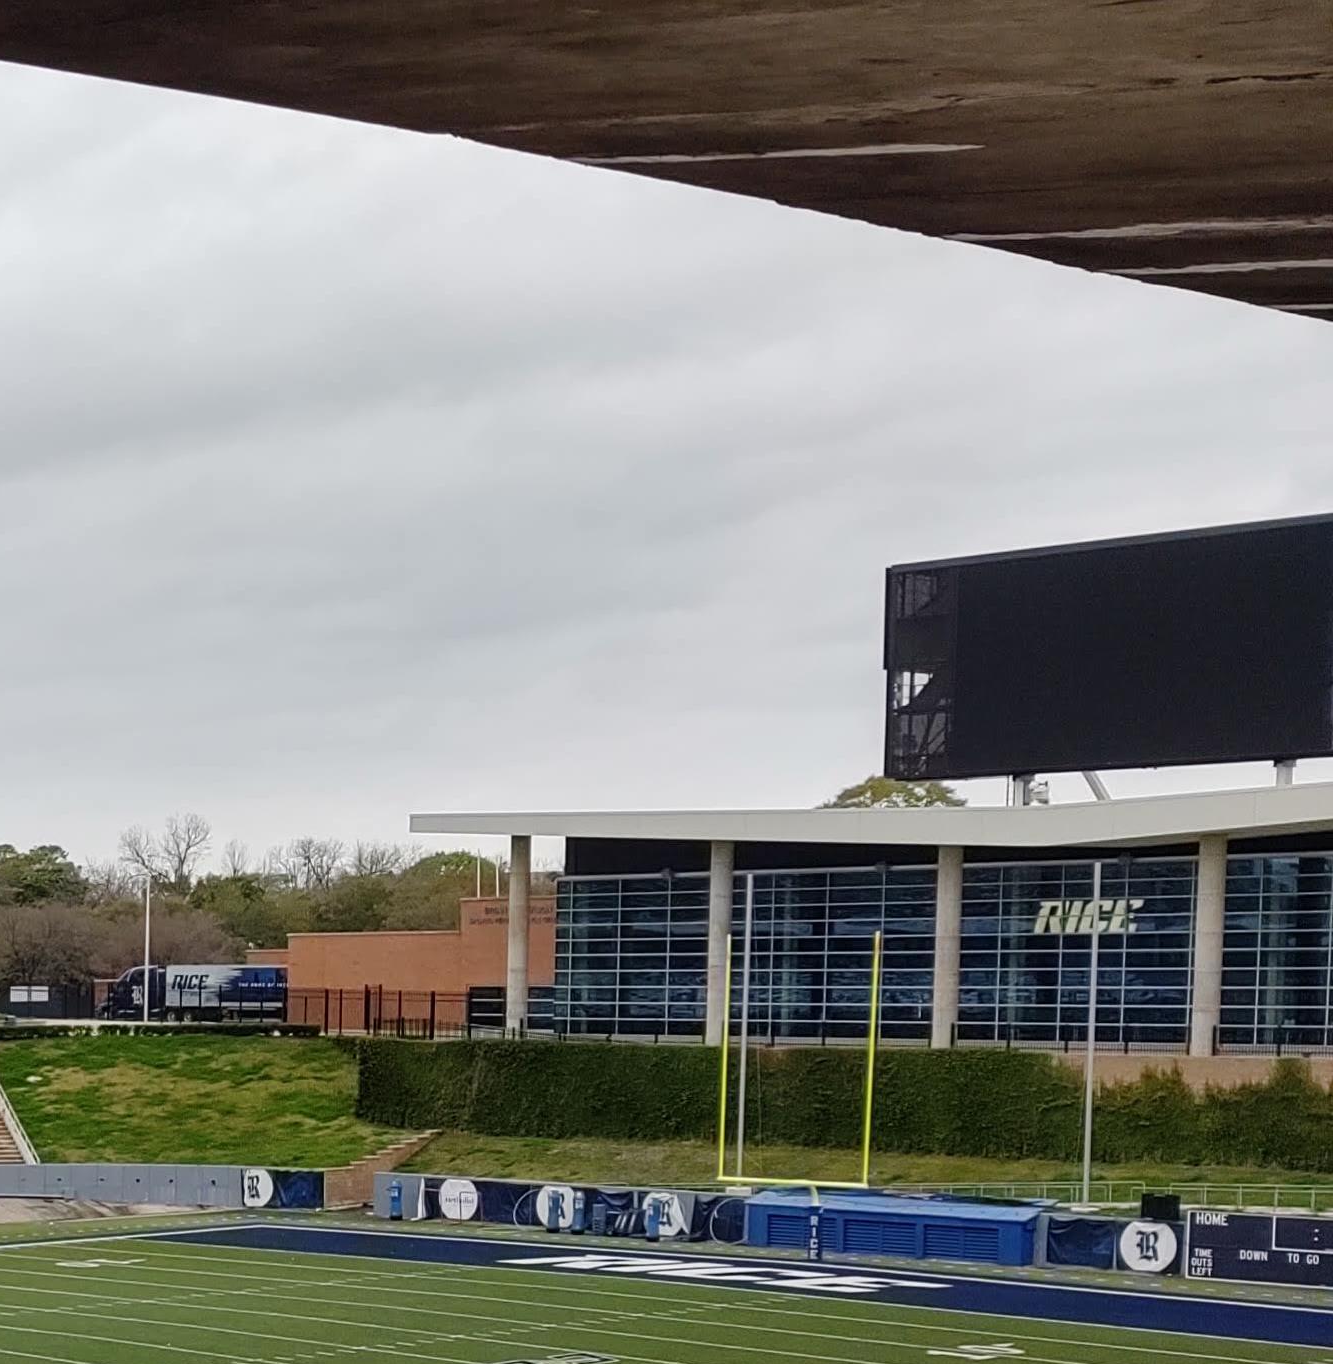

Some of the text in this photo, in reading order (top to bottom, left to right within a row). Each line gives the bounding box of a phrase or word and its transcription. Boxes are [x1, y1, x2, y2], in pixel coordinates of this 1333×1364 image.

[1033, 899, 1146, 934] RICE
[171, 974, 210, 990] RICE
[1196, 1212, 1229, 1226] HOME
[810, 1215, 819, 1260] RICE
[1136, 1229, 1159, 1262] R
[1194, 1247, 1213, 1258] TIME
[1191, 1257, 1213, 1267] OUTS
[1239, 1249, 1268, 1261] DOWN
[1287, 1253, 1320, 1265] TO GO
[495, 1253, 955, 1293] RICE
[1191, 1267, 1213, 1277] LEFT
